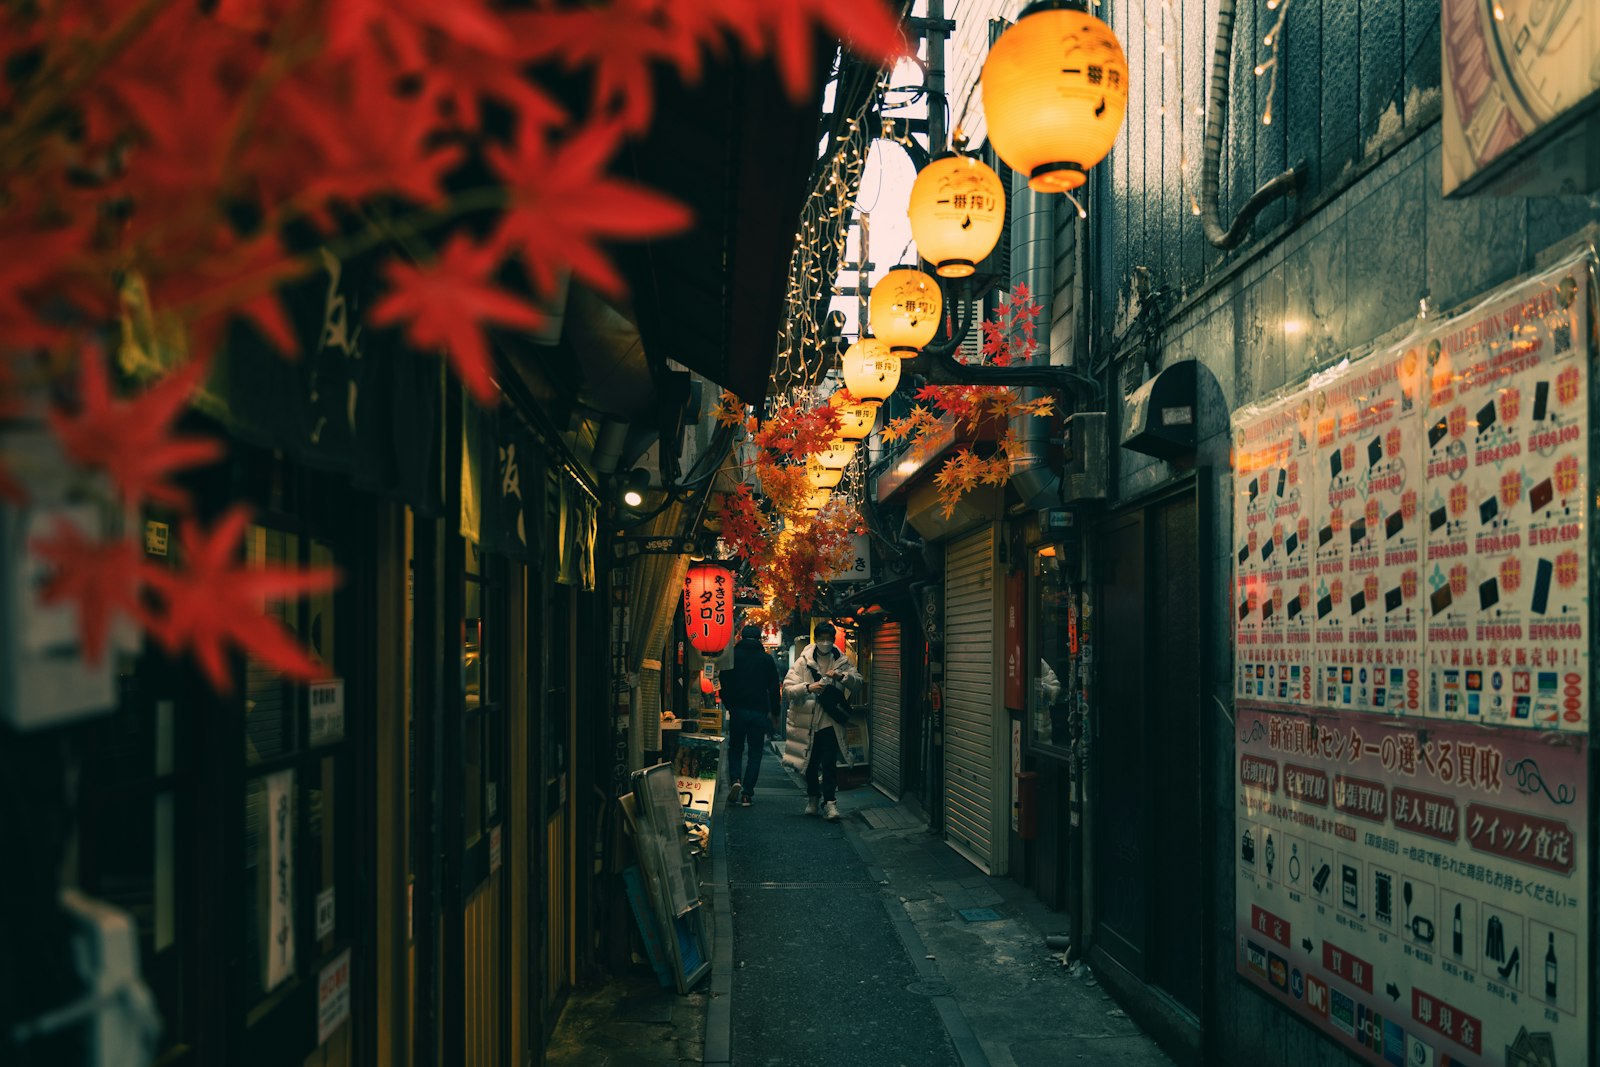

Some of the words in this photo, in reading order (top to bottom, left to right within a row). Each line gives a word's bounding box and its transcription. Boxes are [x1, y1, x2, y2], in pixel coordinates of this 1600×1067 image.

[1061, 64, 1125, 96] 一番搾
[937, 194, 995, 212] 一番搾り
[893, 300, 936, 315] 一番搾り
[865, 361, 898, 373] 一番搾り
[699, 591, 713, 637] タロー
[714, 575, 726, 625] やきとり
[1242, 760, 1276, 786] 店頭買取
[1269, 719, 1501, 793] 新宿買取センターの選べる買取
[1285, 770, 1326, 801] 宅配買取
[1335, 780, 1384, 817] 出張買取
[1395, 796, 1455, 834] 法人買取
[1470, 812, 1570, 867] クイック査定
[1258, 911, 1284, 943] 査定
[1331, 949, 1365, 985] 買取
[1307, 979, 1326, 1013] DC
[1357, 1018, 1381, 1042] JCB
[1418, 995, 1475, 1049] 即現金
